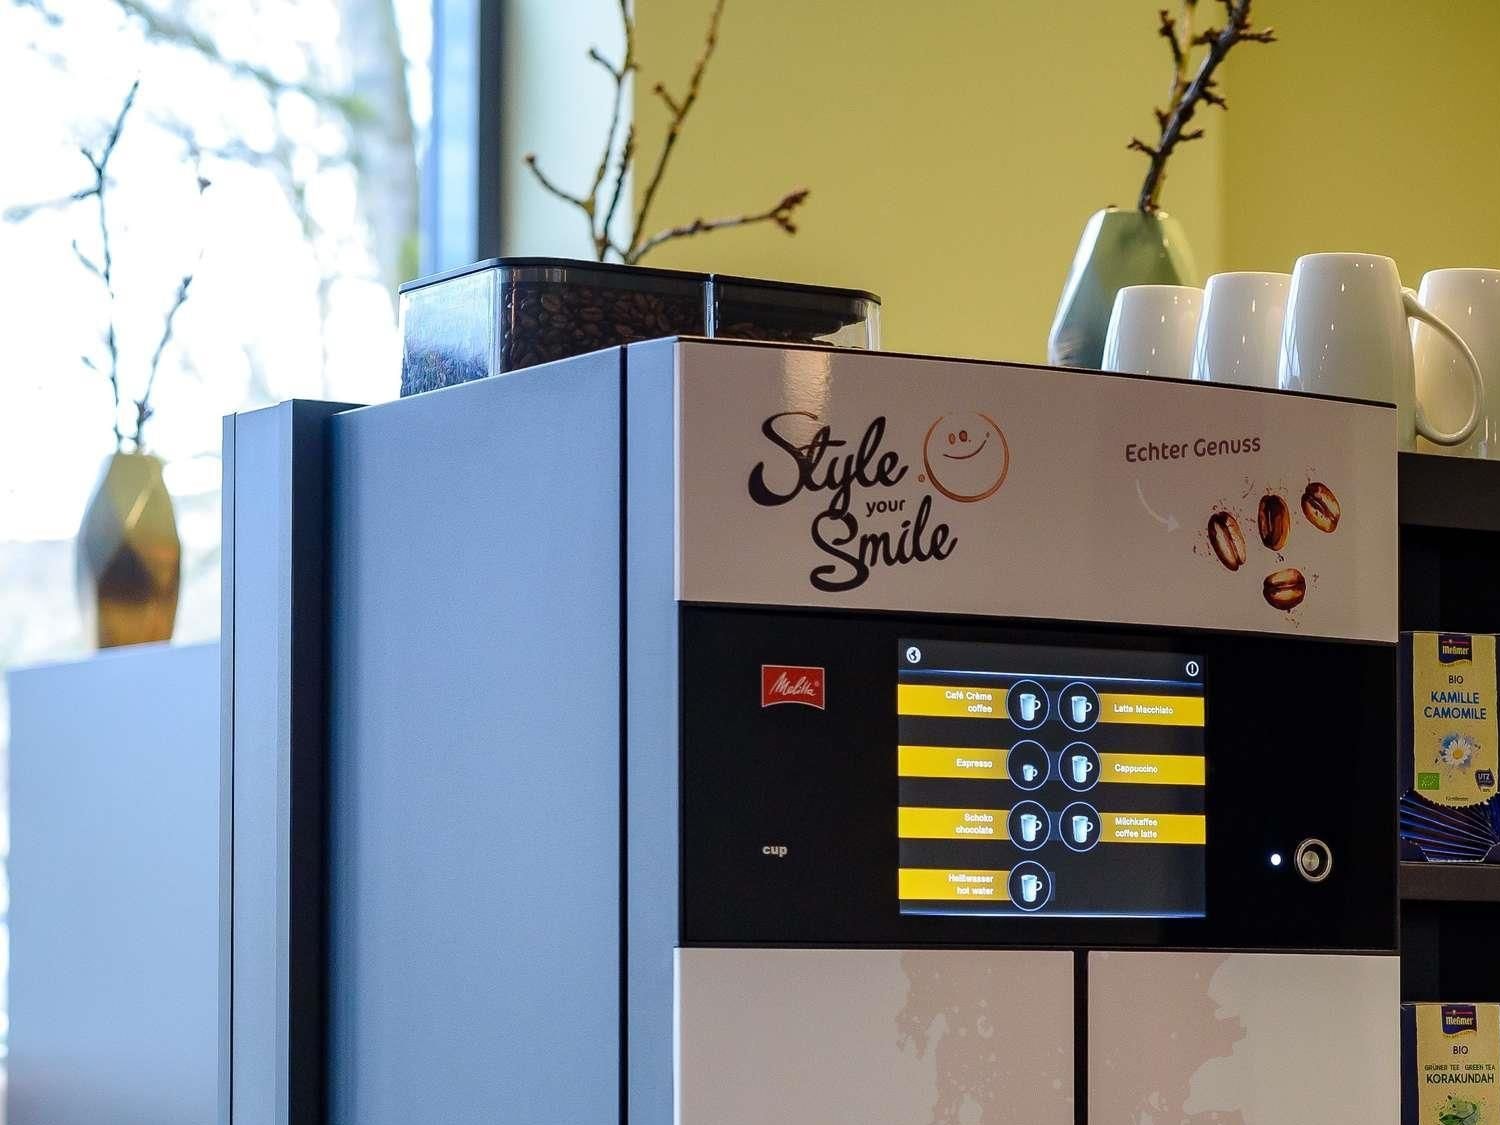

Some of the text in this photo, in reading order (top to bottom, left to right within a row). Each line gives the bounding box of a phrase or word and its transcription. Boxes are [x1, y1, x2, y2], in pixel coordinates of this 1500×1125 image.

[1125, 435, 1262, 464] Echter Genuss
[747, 411, 909, 518] Style
[865, 496, 906, 518] your
[809, 494, 959, 593] Smile
[768, 671, 817, 697] Melitta
[1448, 674, 1464, 685] BIO
[1430, 690, 1481, 705] KAMILLE
[967, 703, 993, 713] coffee
[1114, 704, 1174, 715] Latte Macchiato
[1423, 706, 1488, 721] CAMOMILE
[956, 758, 993, 770] Espresso
[1114, 763, 1159, 775] Cappuccino
[964, 813, 993, 823] Schoko
[1115, 817, 1158, 827] Milchkaffee
[955, 825, 994, 836] chocolate
[1115, 829, 1158, 839] coffee latte
[762, 844, 789, 858] cup
[957, 886, 994, 896] hot water
[1452, 1045, 1469, 1055] BIO
[1424, 1063, 1449, 1071] GRÜNER
[1426, 1073, 1495, 1085] KORAKUNDAH
